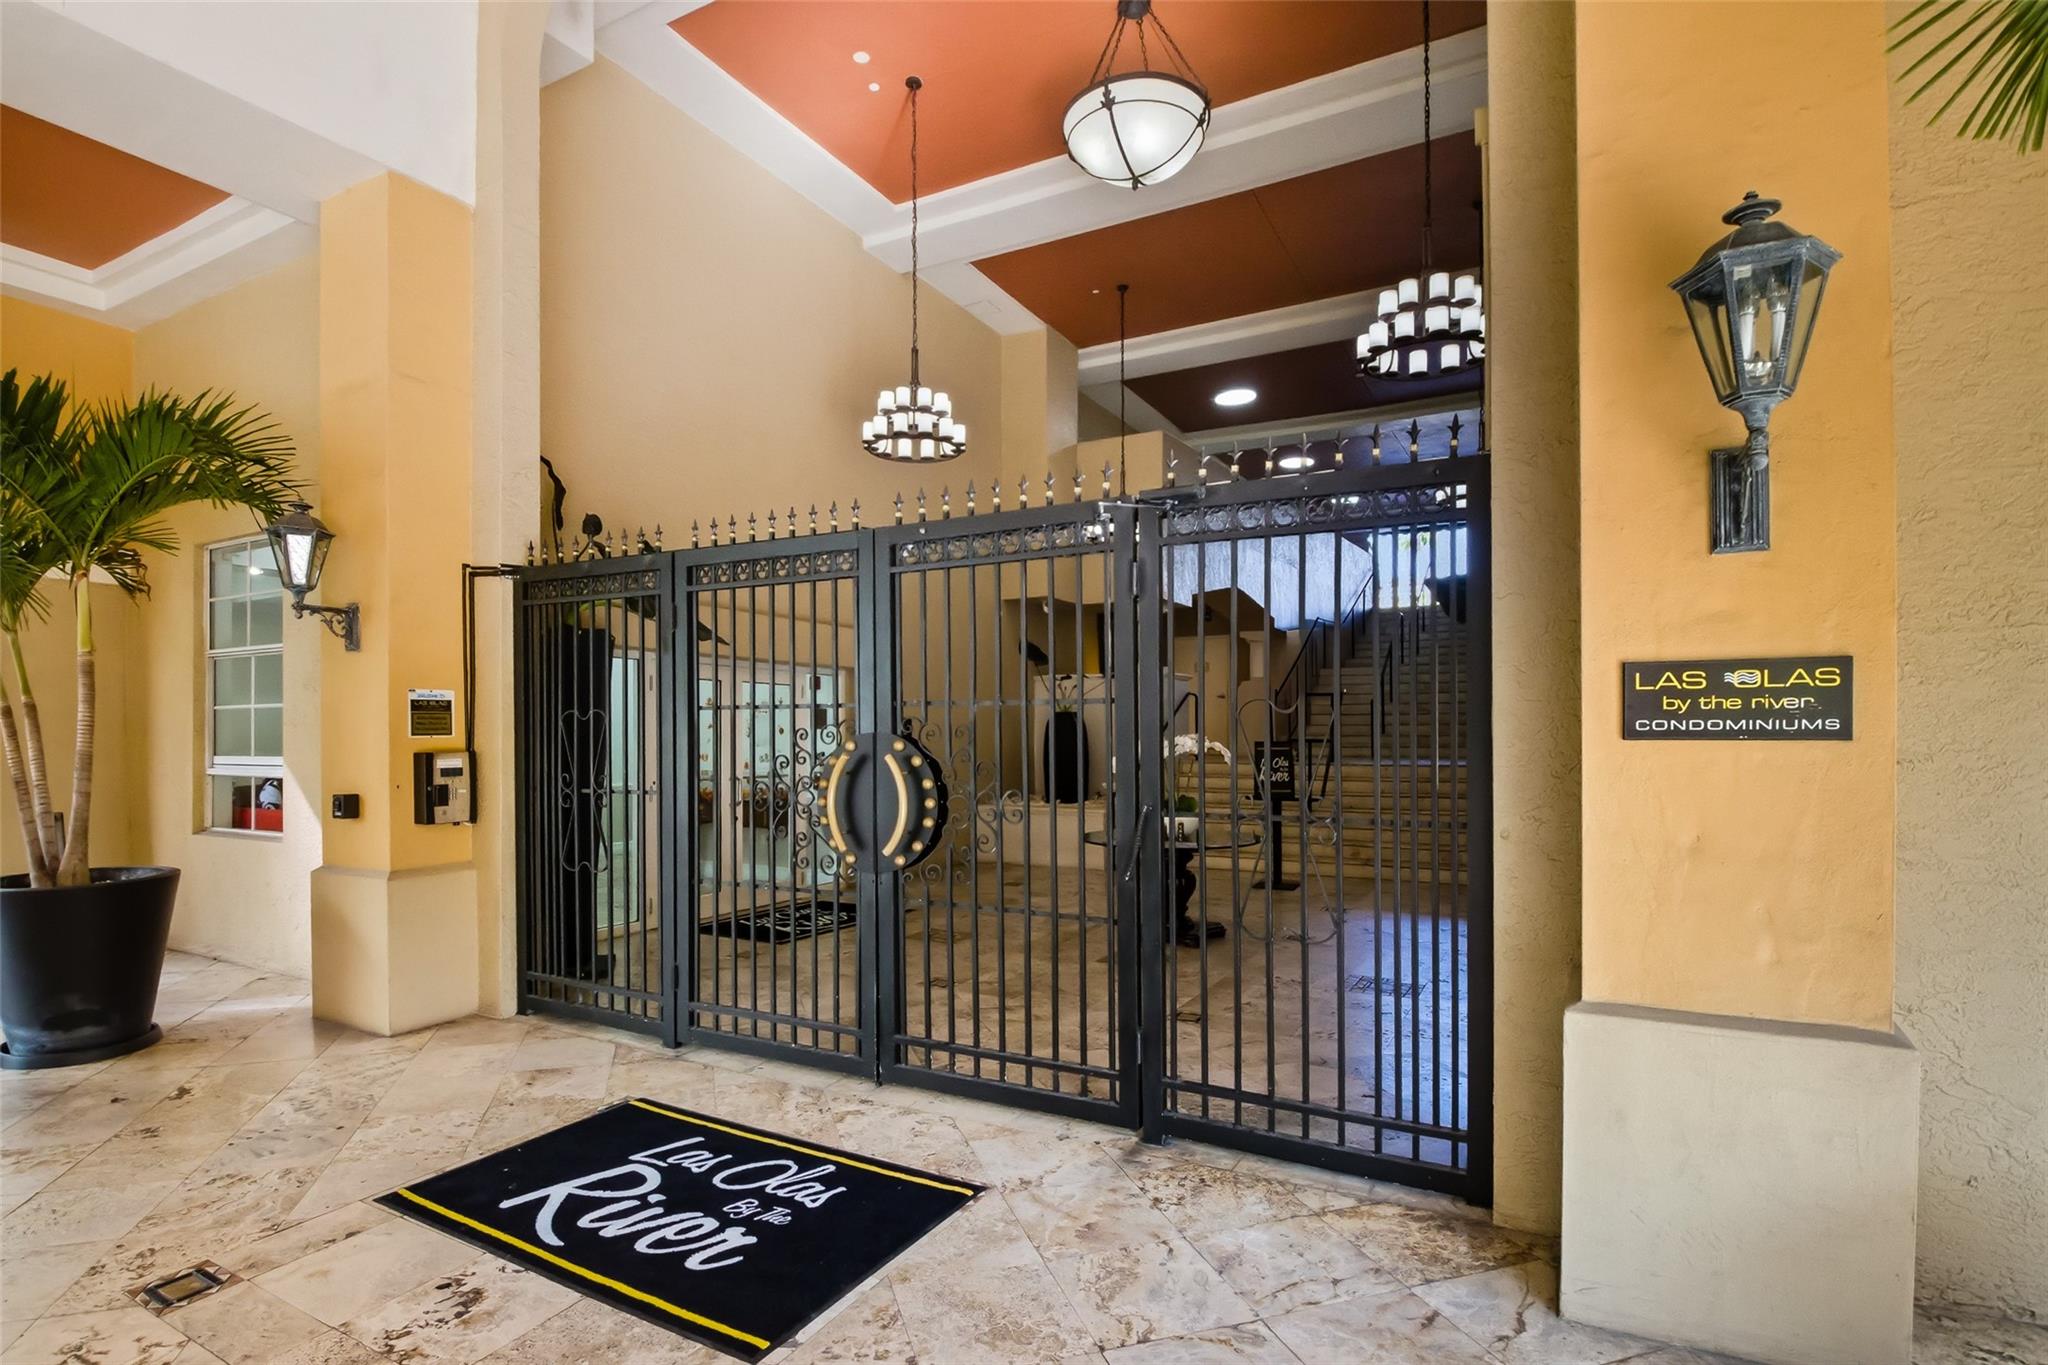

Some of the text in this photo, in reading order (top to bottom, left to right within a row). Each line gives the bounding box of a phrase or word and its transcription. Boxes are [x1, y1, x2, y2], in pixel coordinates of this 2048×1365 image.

[1635, 667, 1841, 690] LAS OLAS
[1662, 694, 1815, 714] by the river
[1635, 718, 1841, 731] CONDOMINIUMS
[628, 1136, 848, 1208] Las Olas
[499, 1163, 758, 1271] River
[722, 1198, 792, 1225] By The
